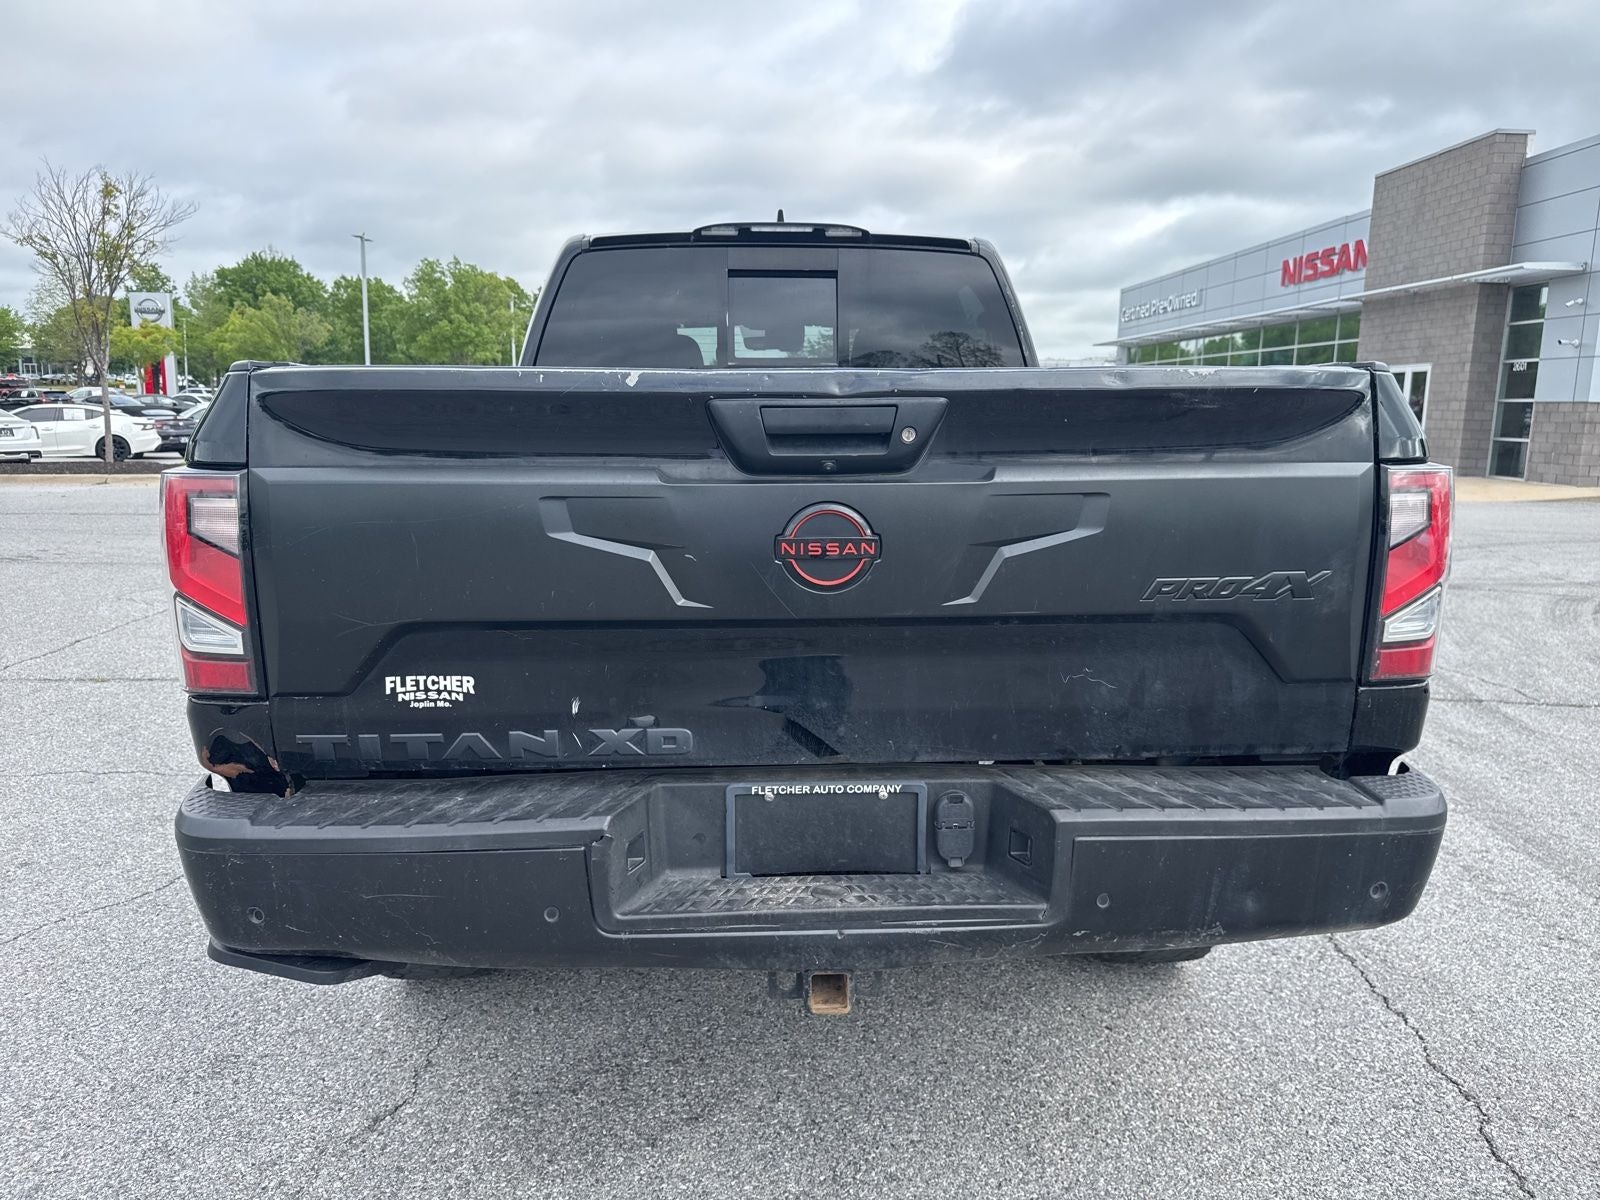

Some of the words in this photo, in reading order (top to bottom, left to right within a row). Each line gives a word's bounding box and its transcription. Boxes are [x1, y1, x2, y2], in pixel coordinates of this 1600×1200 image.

[1281, 239, 1368, 287] NISSAN
[1150, 287, 1198, 316] Pre-Owned
[781, 542, 875, 556] NISSAN
[1139, 569, 1333, 602] PRO4X
[384, 675, 475, 695] FLETCHER
[397, 691, 464, 702] NISSAN
[409, 701, 435, 709] Joplin
[295, 729, 560, 761] TITAN
[587, 727, 694, 757] XD
[751, 785, 811, 796] FLETCHER
[812, 785, 844, 794] AUTO
[846, 784, 902, 794] COMPANY
